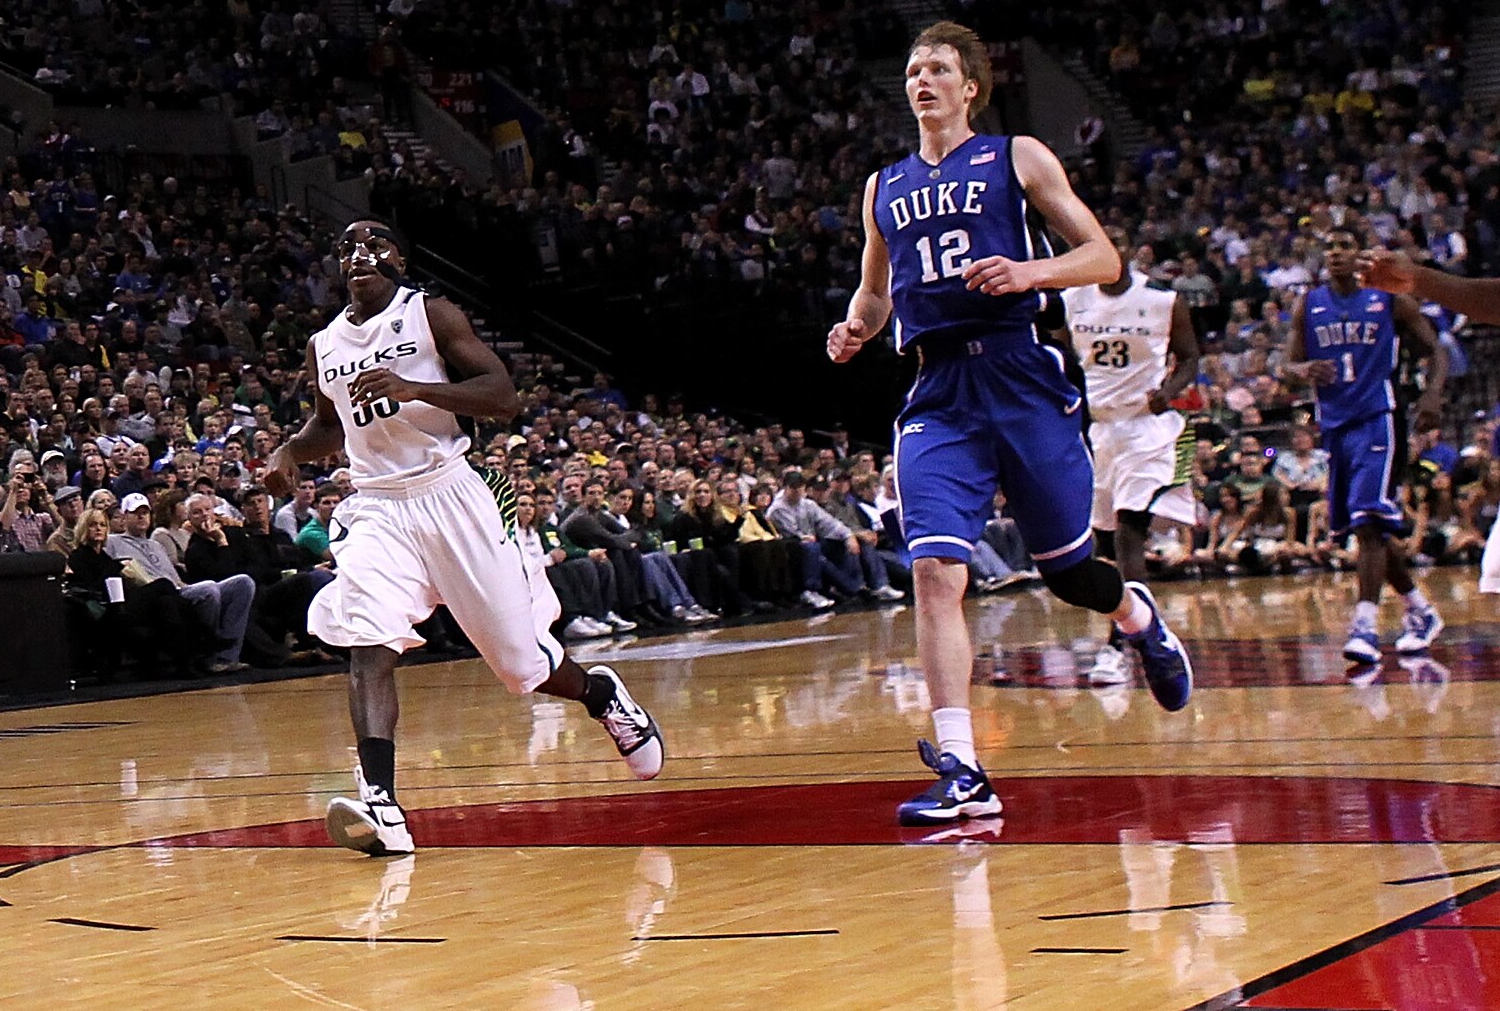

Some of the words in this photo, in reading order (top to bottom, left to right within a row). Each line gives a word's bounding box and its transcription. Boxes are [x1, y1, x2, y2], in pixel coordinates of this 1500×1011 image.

[889, 180, 987, 230] DUKE
[916, 229, 973, 284] 12
[1075, 325, 1150, 336] DUCKS
[1314, 321, 1379, 348] DUKE
[324, 341, 418, 383] DUCKS
[1092, 340, 1129, 368] 23
[1341, 352, 1357, 382] 1
